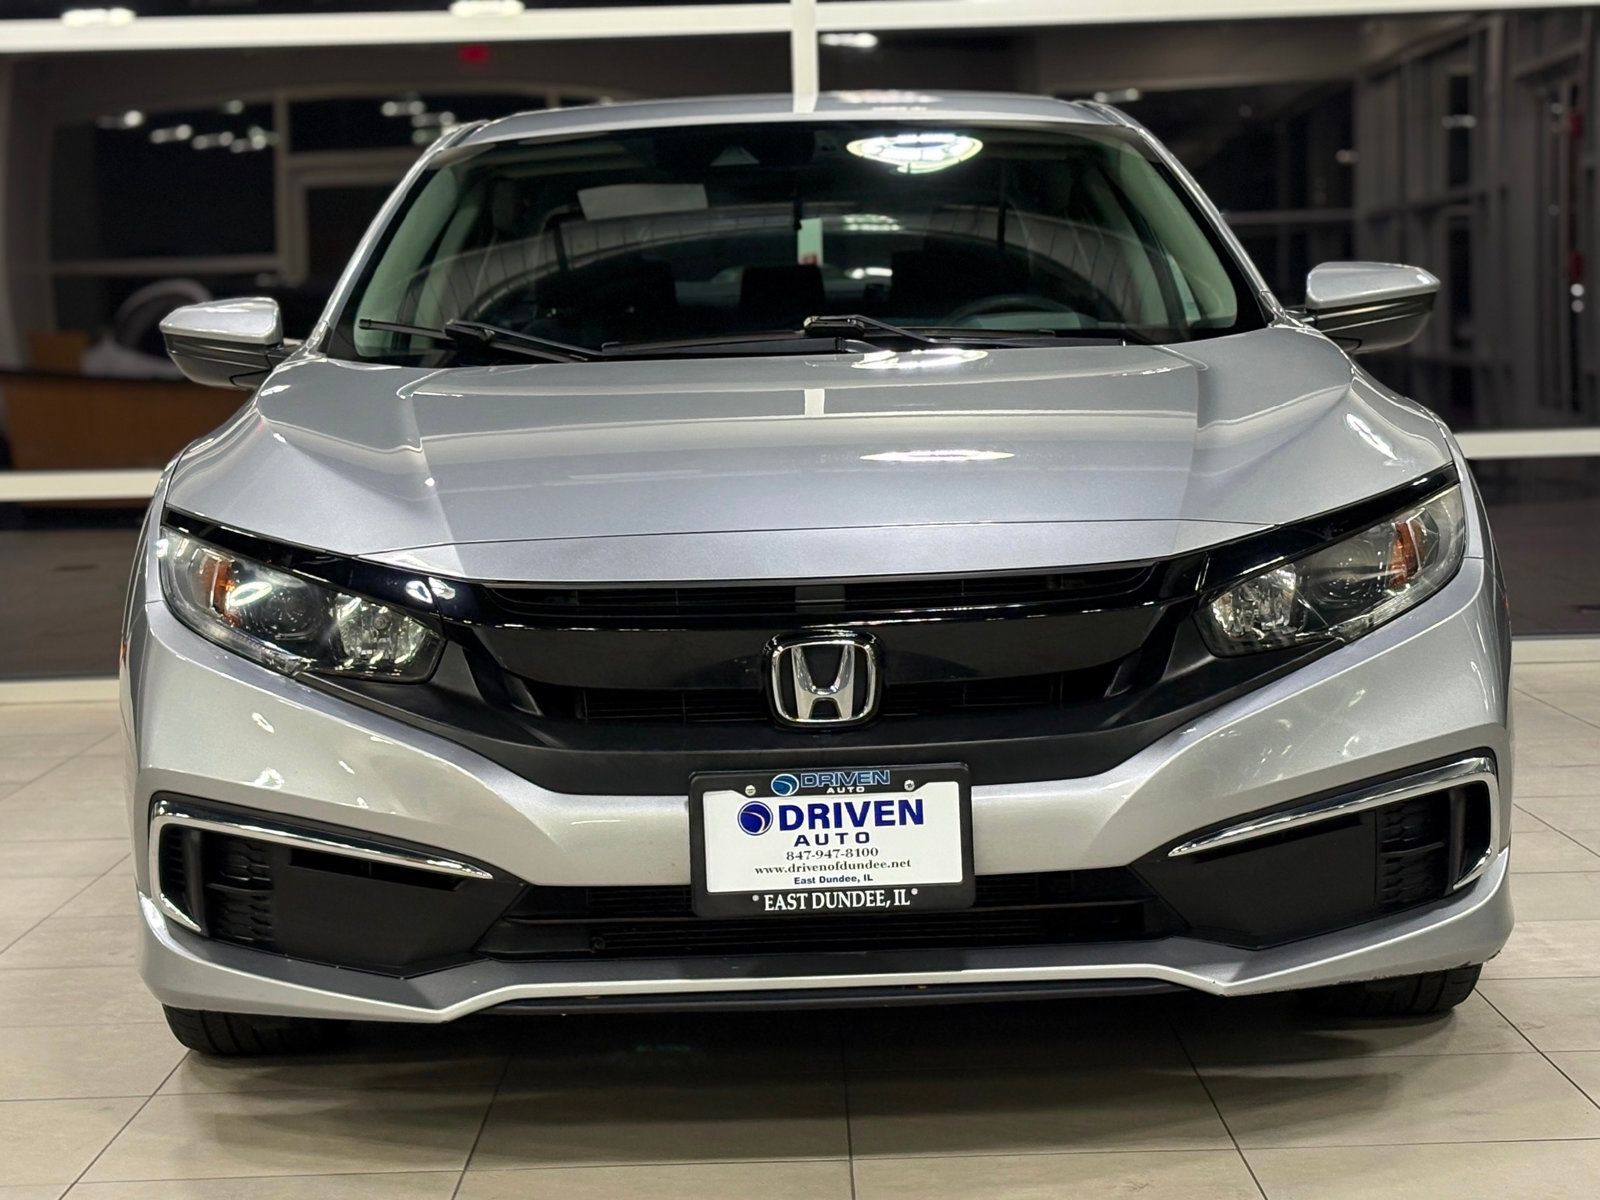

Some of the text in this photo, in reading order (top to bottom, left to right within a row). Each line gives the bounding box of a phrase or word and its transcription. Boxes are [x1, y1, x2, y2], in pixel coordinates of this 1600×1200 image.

[801, 770, 890, 788] DRIVEN
[827, 786, 865, 794] AUTO
[779, 799, 924, 831] DRIVEN
[794, 832, 870, 847] AUTO
[786, 847, 879, 861] 847-947-8100
[755, 859, 911, 875] www.drivenofdundee.net
[794, 874, 873, 885] East Dundee, IL
[764, 888, 910, 911] EAST DUNDEE, IL
